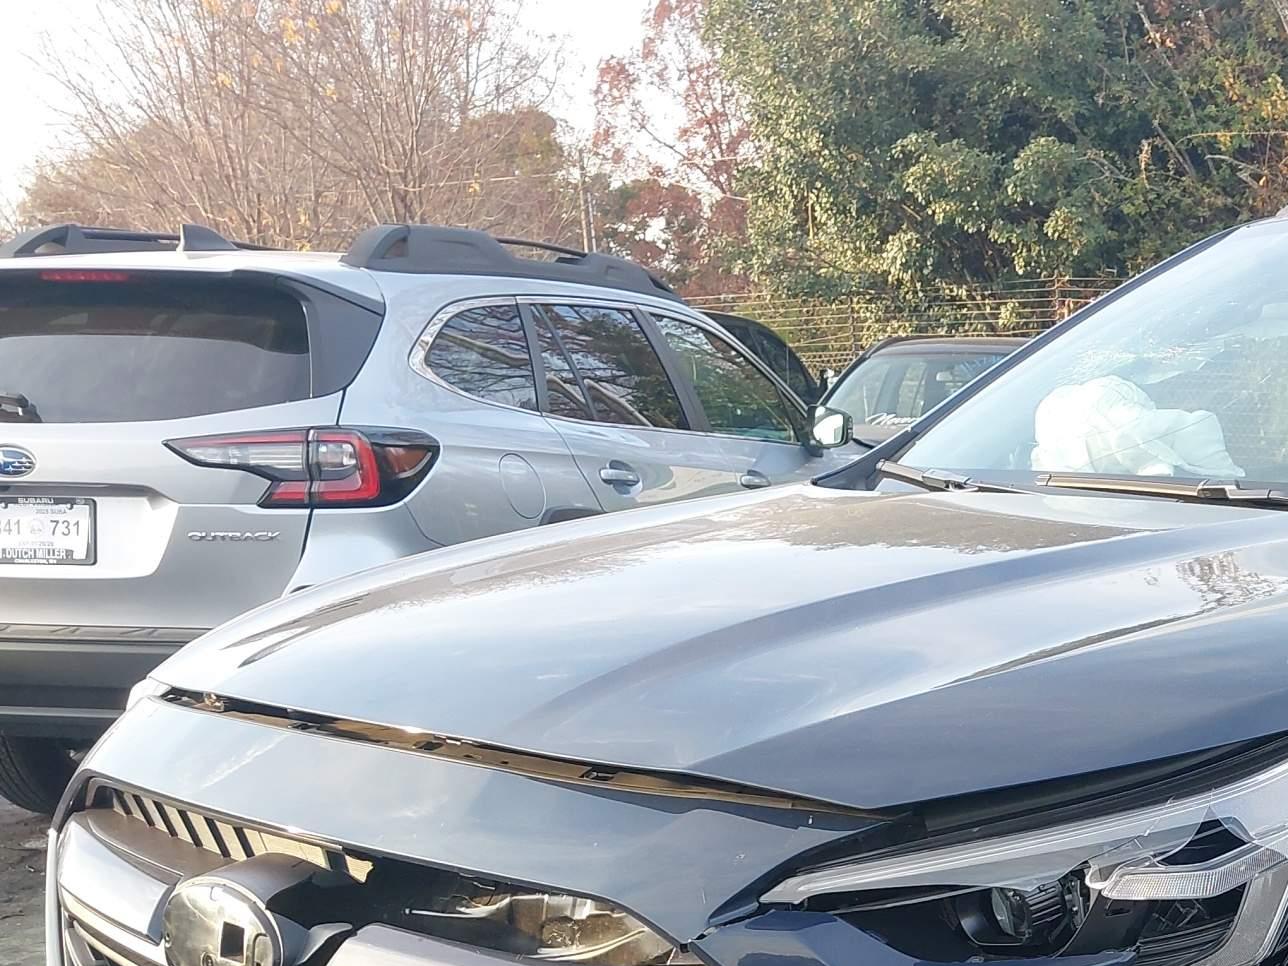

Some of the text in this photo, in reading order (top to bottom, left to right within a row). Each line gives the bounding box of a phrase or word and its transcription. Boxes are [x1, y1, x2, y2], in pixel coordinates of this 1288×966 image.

[0, 519, 80, 536] 41 731
[187, 531, 280, 541] OUTBACK
[6, 548, 66, 559] DUTCH MILLER
